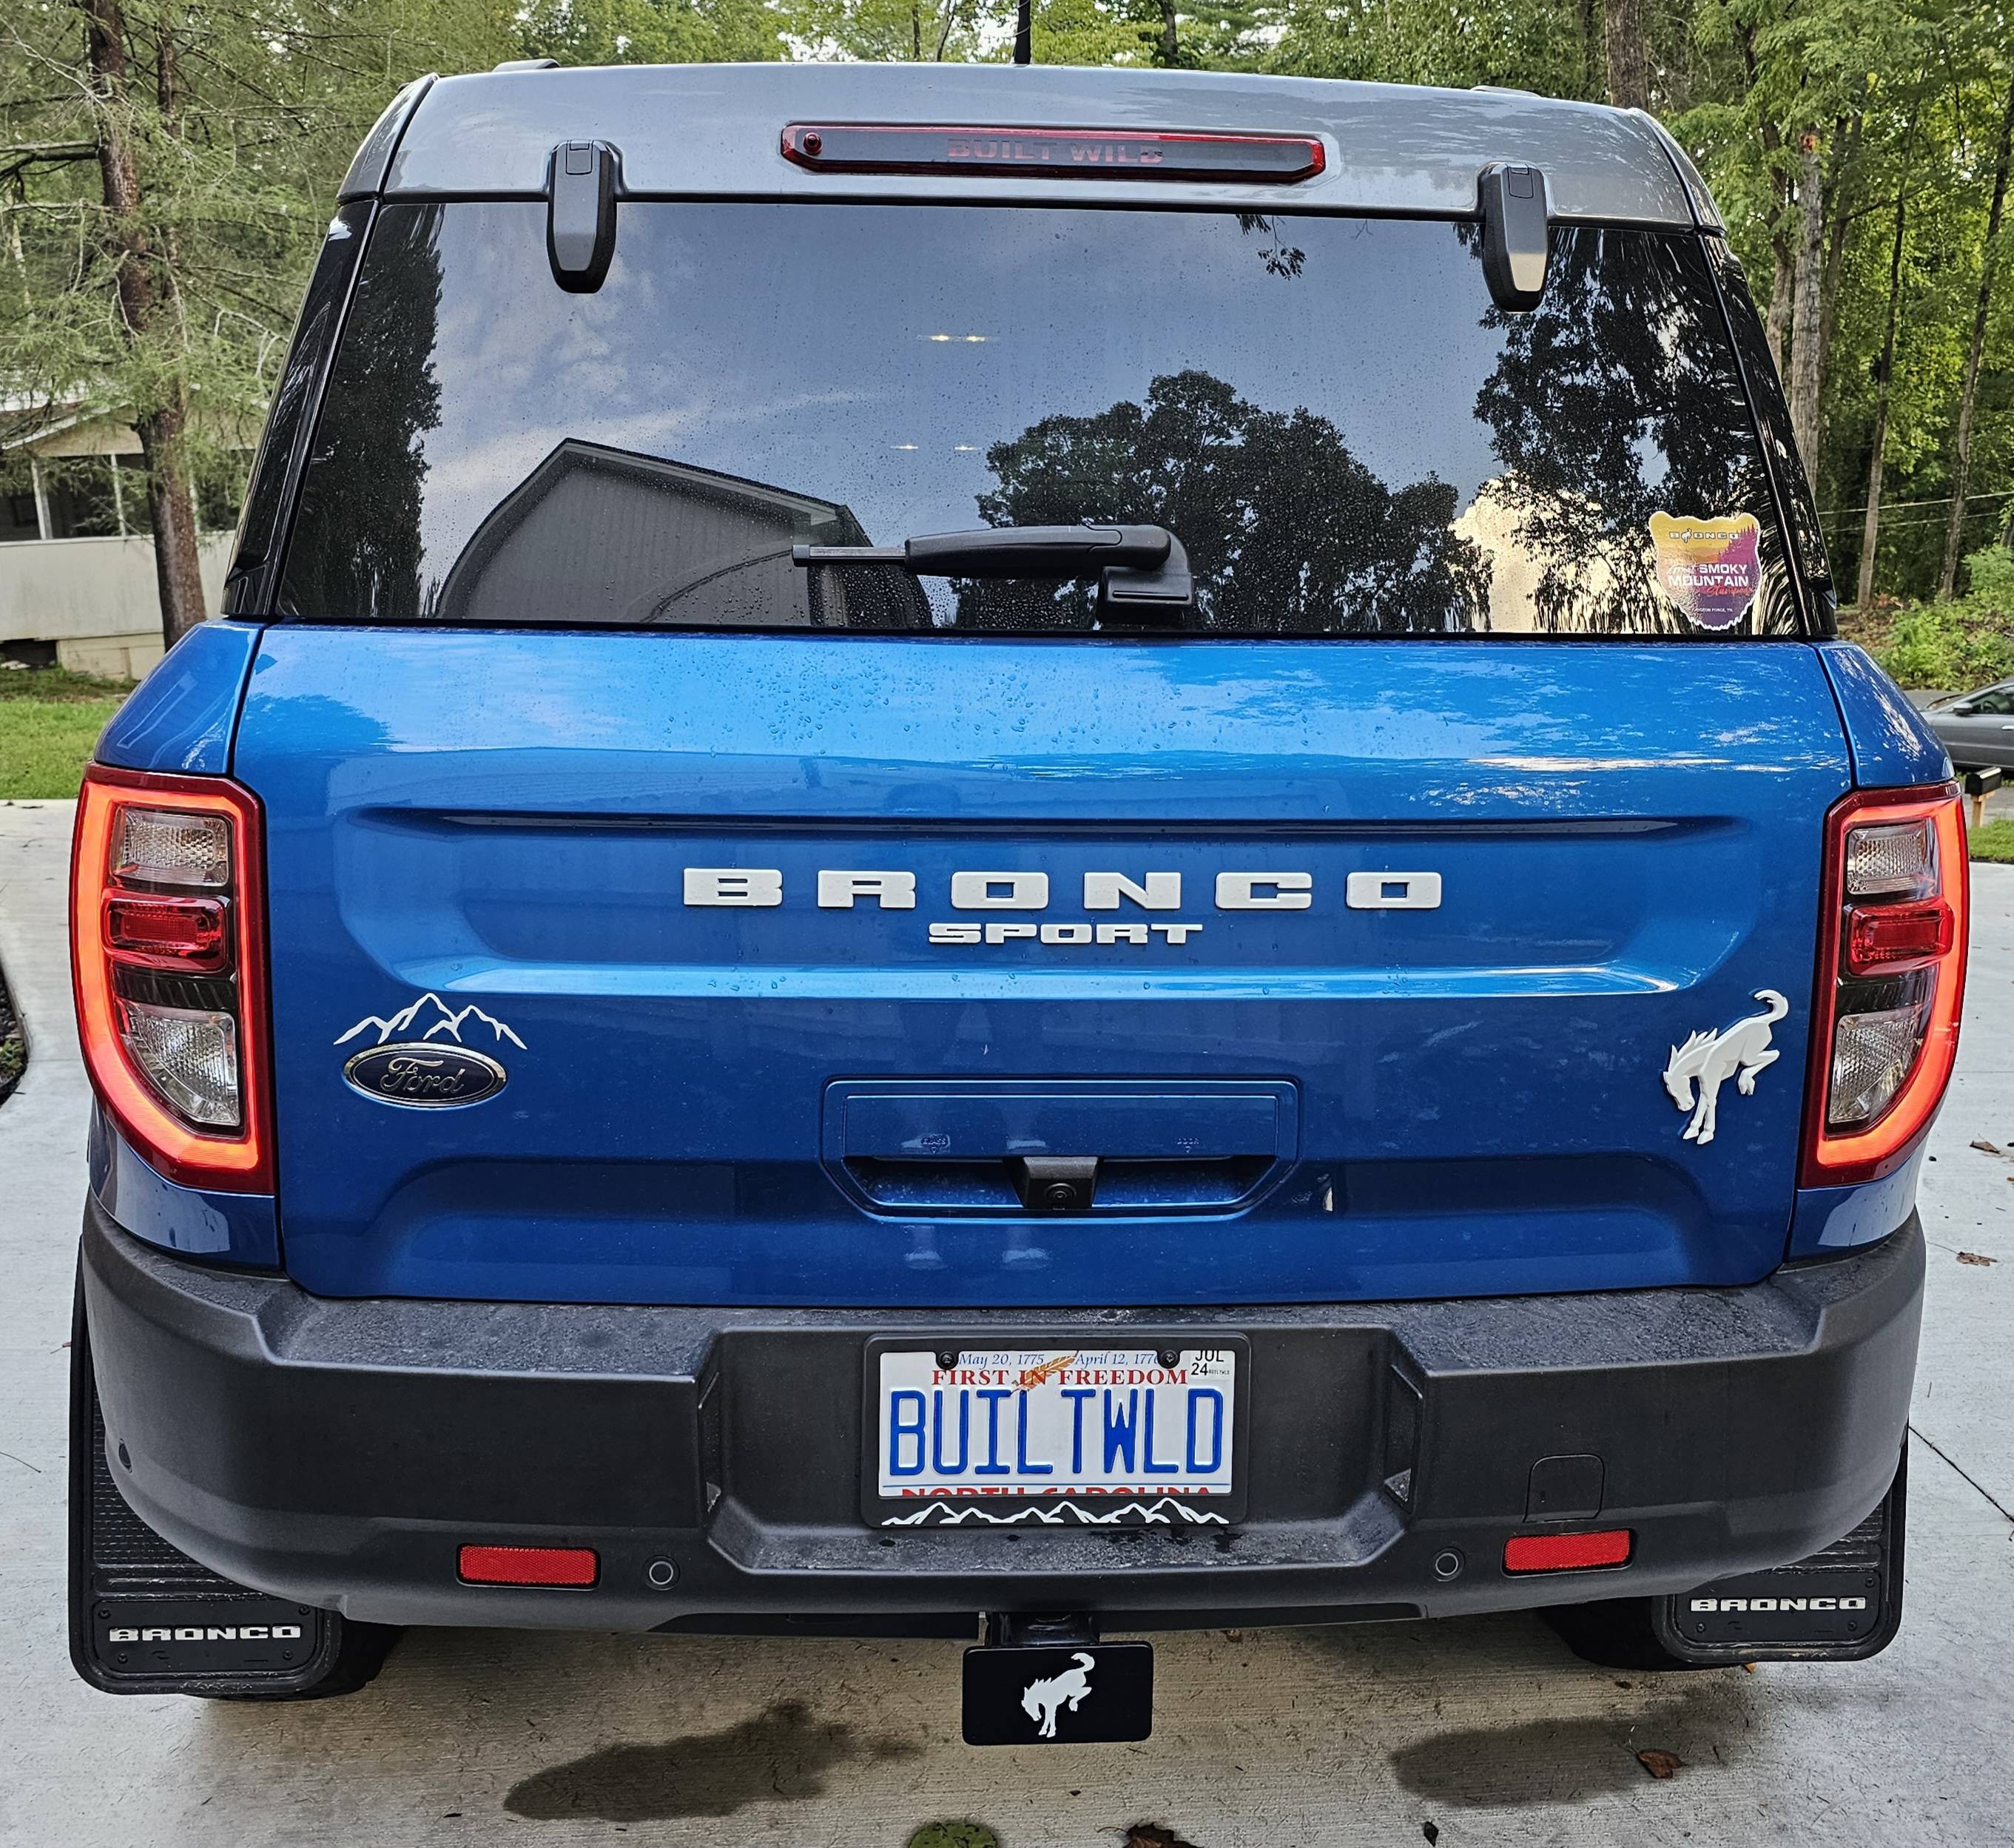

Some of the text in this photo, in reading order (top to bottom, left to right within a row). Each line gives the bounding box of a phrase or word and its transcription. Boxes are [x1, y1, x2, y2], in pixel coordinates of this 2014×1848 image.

[946, 138, 1163, 163] BUILT WILD
[1699, 563, 1748, 575] SMOKY
[1668, 575, 1749, 587] MOUNTAIN
[683, 867, 1443, 911] BRONCO
[928, 922, 1203, 945] SPORT
[380, 1057, 466, 1093] Ford
[959, 1353, 1045, 1370] May 20, 1775
[1074, 1352, 1111, 1369] April
[1112, 1353, 1128, 1366] 12,
[1195, 1350, 1225, 1362] JUL
[931, 1369, 1188, 1386] FIRST IN FREEDOM
[1190, 1362, 1208, 1376] 24
[889, 1389, 1224, 1477] BUILTWLD
[1690, 1596, 1867, 1612] BRONCO
[109, 1625, 301, 1642] BRONCO
